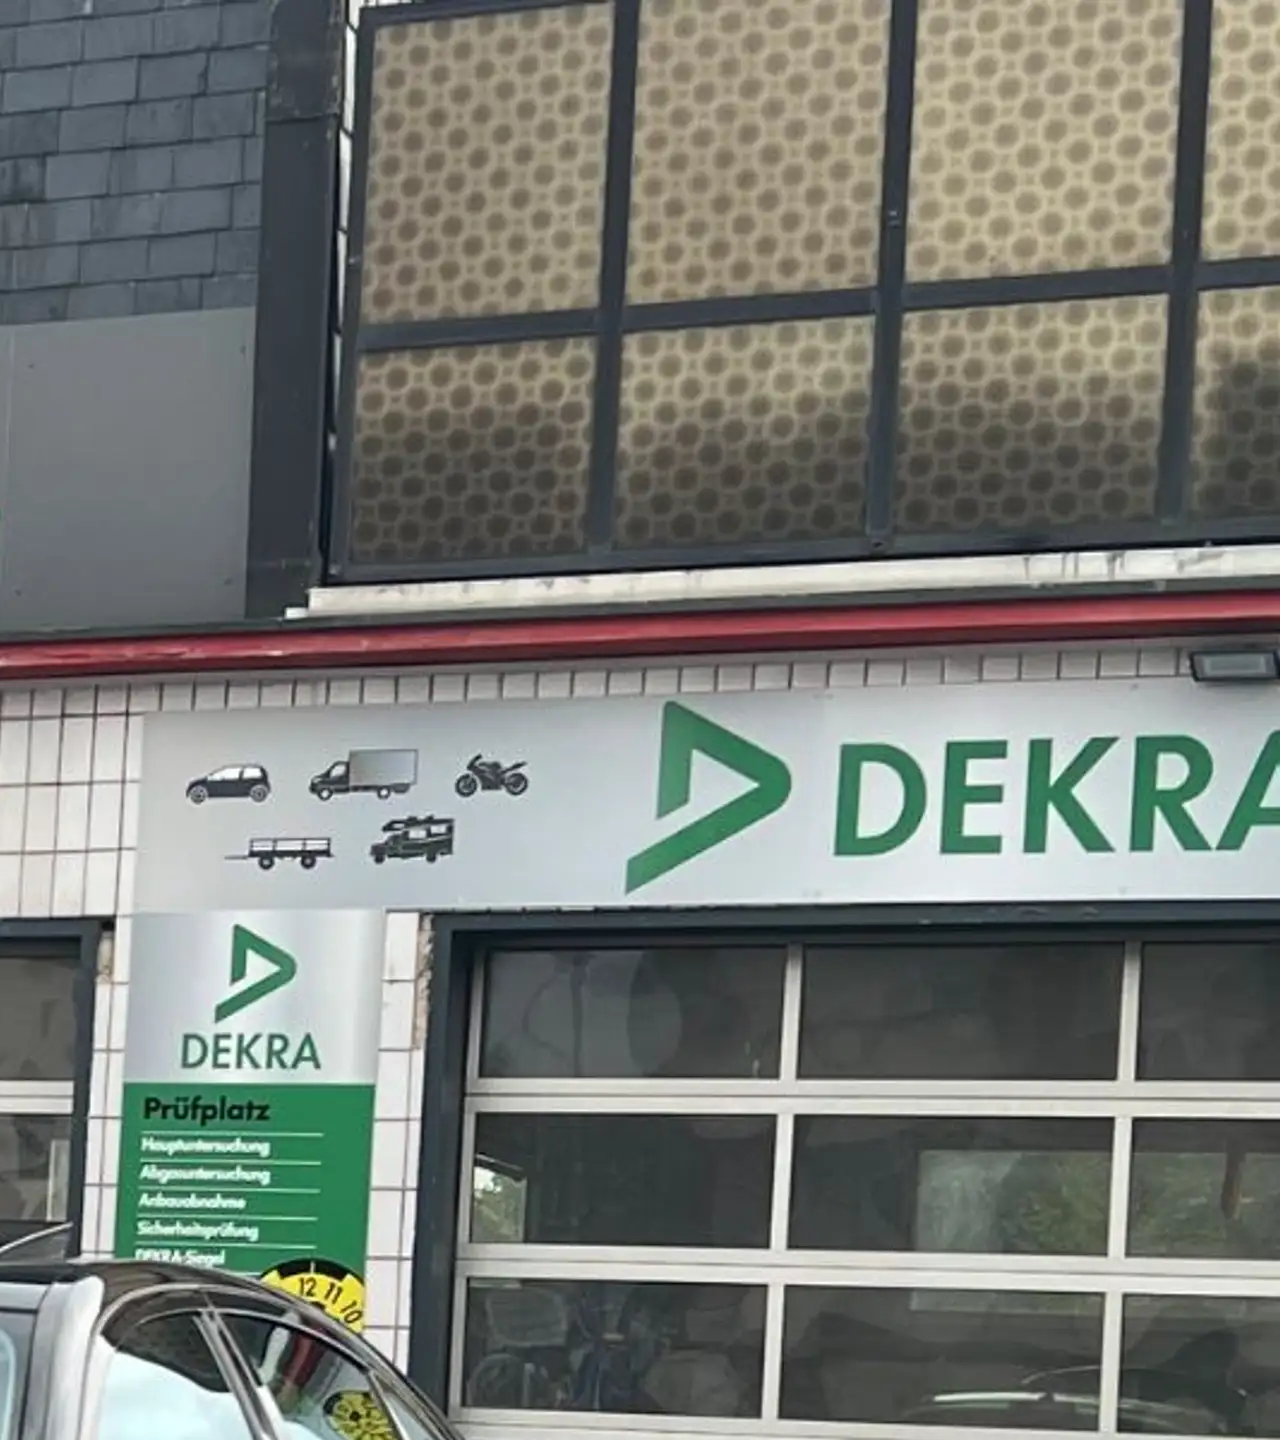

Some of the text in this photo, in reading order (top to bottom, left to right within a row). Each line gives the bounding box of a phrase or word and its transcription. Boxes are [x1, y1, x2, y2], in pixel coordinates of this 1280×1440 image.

[834, 730, 1280, 857] DEKRA
[180, 1032, 322, 1070] DEKRA
[142, 1094, 272, 1128] Prüfplatz
[141, 1136, 271, 1158] Hauptuntersuchung
[139, 1163, 272, 1186] Abgasuntersuchung
[298, 1276, 364, 1325] 12 11 10
